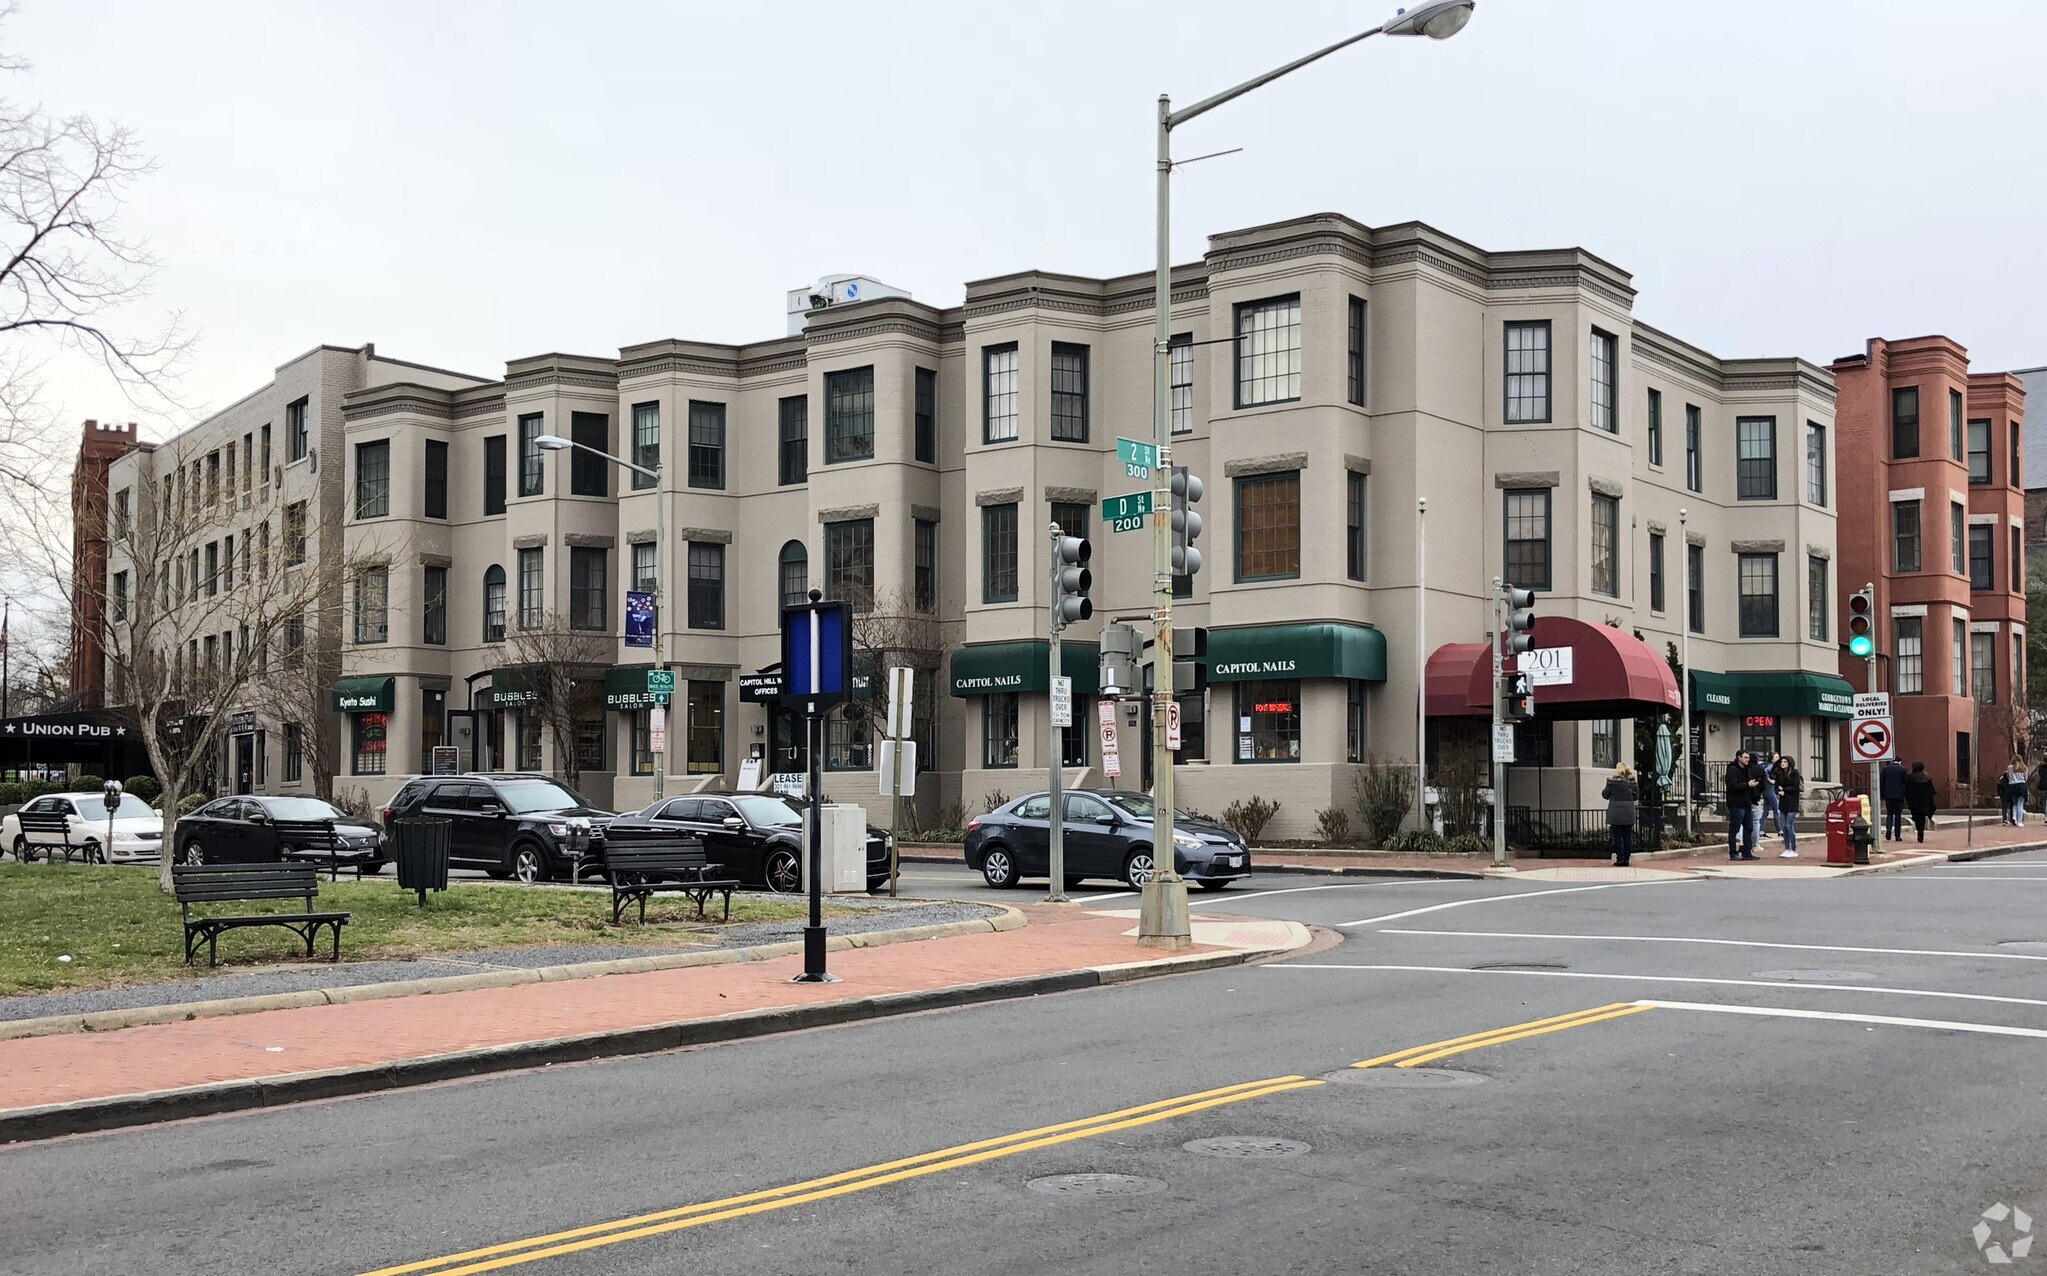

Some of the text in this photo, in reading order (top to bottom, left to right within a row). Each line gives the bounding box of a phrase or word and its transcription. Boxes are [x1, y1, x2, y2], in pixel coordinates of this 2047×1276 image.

[1130, 443, 1138, 461] 2
[1144, 446, 1150, 455] St
[1127, 464, 1148, 479] 300
[1137, 495, 1145, 504] St
[1119, 498, 1128, 515] D
[1115, 516, 1141, 532] 200
[1528, 649, 1560, 670] 201
[1215, 660, 1296, 675] CAPITOL NAILS
[740, 677, 763, 686] CAPITOL
[764, 677, 776, 685] HILL
[955, 674, 1022, 689] CAPITOL NAILS
[1057, 679, 1065, 687] NO
[493, 691, 538, 702] BUBBLES
[754, 687, 778, 695] OFFICES
[339, 695, 377, 709] Kyoto Sushi
[607, 692, 656, 704] BUBBLES
[1706, 693, 1731, 705] CLEANERS
[1858, 708, 1886, 717] ONLY!
[1746, 716, 1773, 727] OPEN
[774, 774, 802, 783] LEASE
